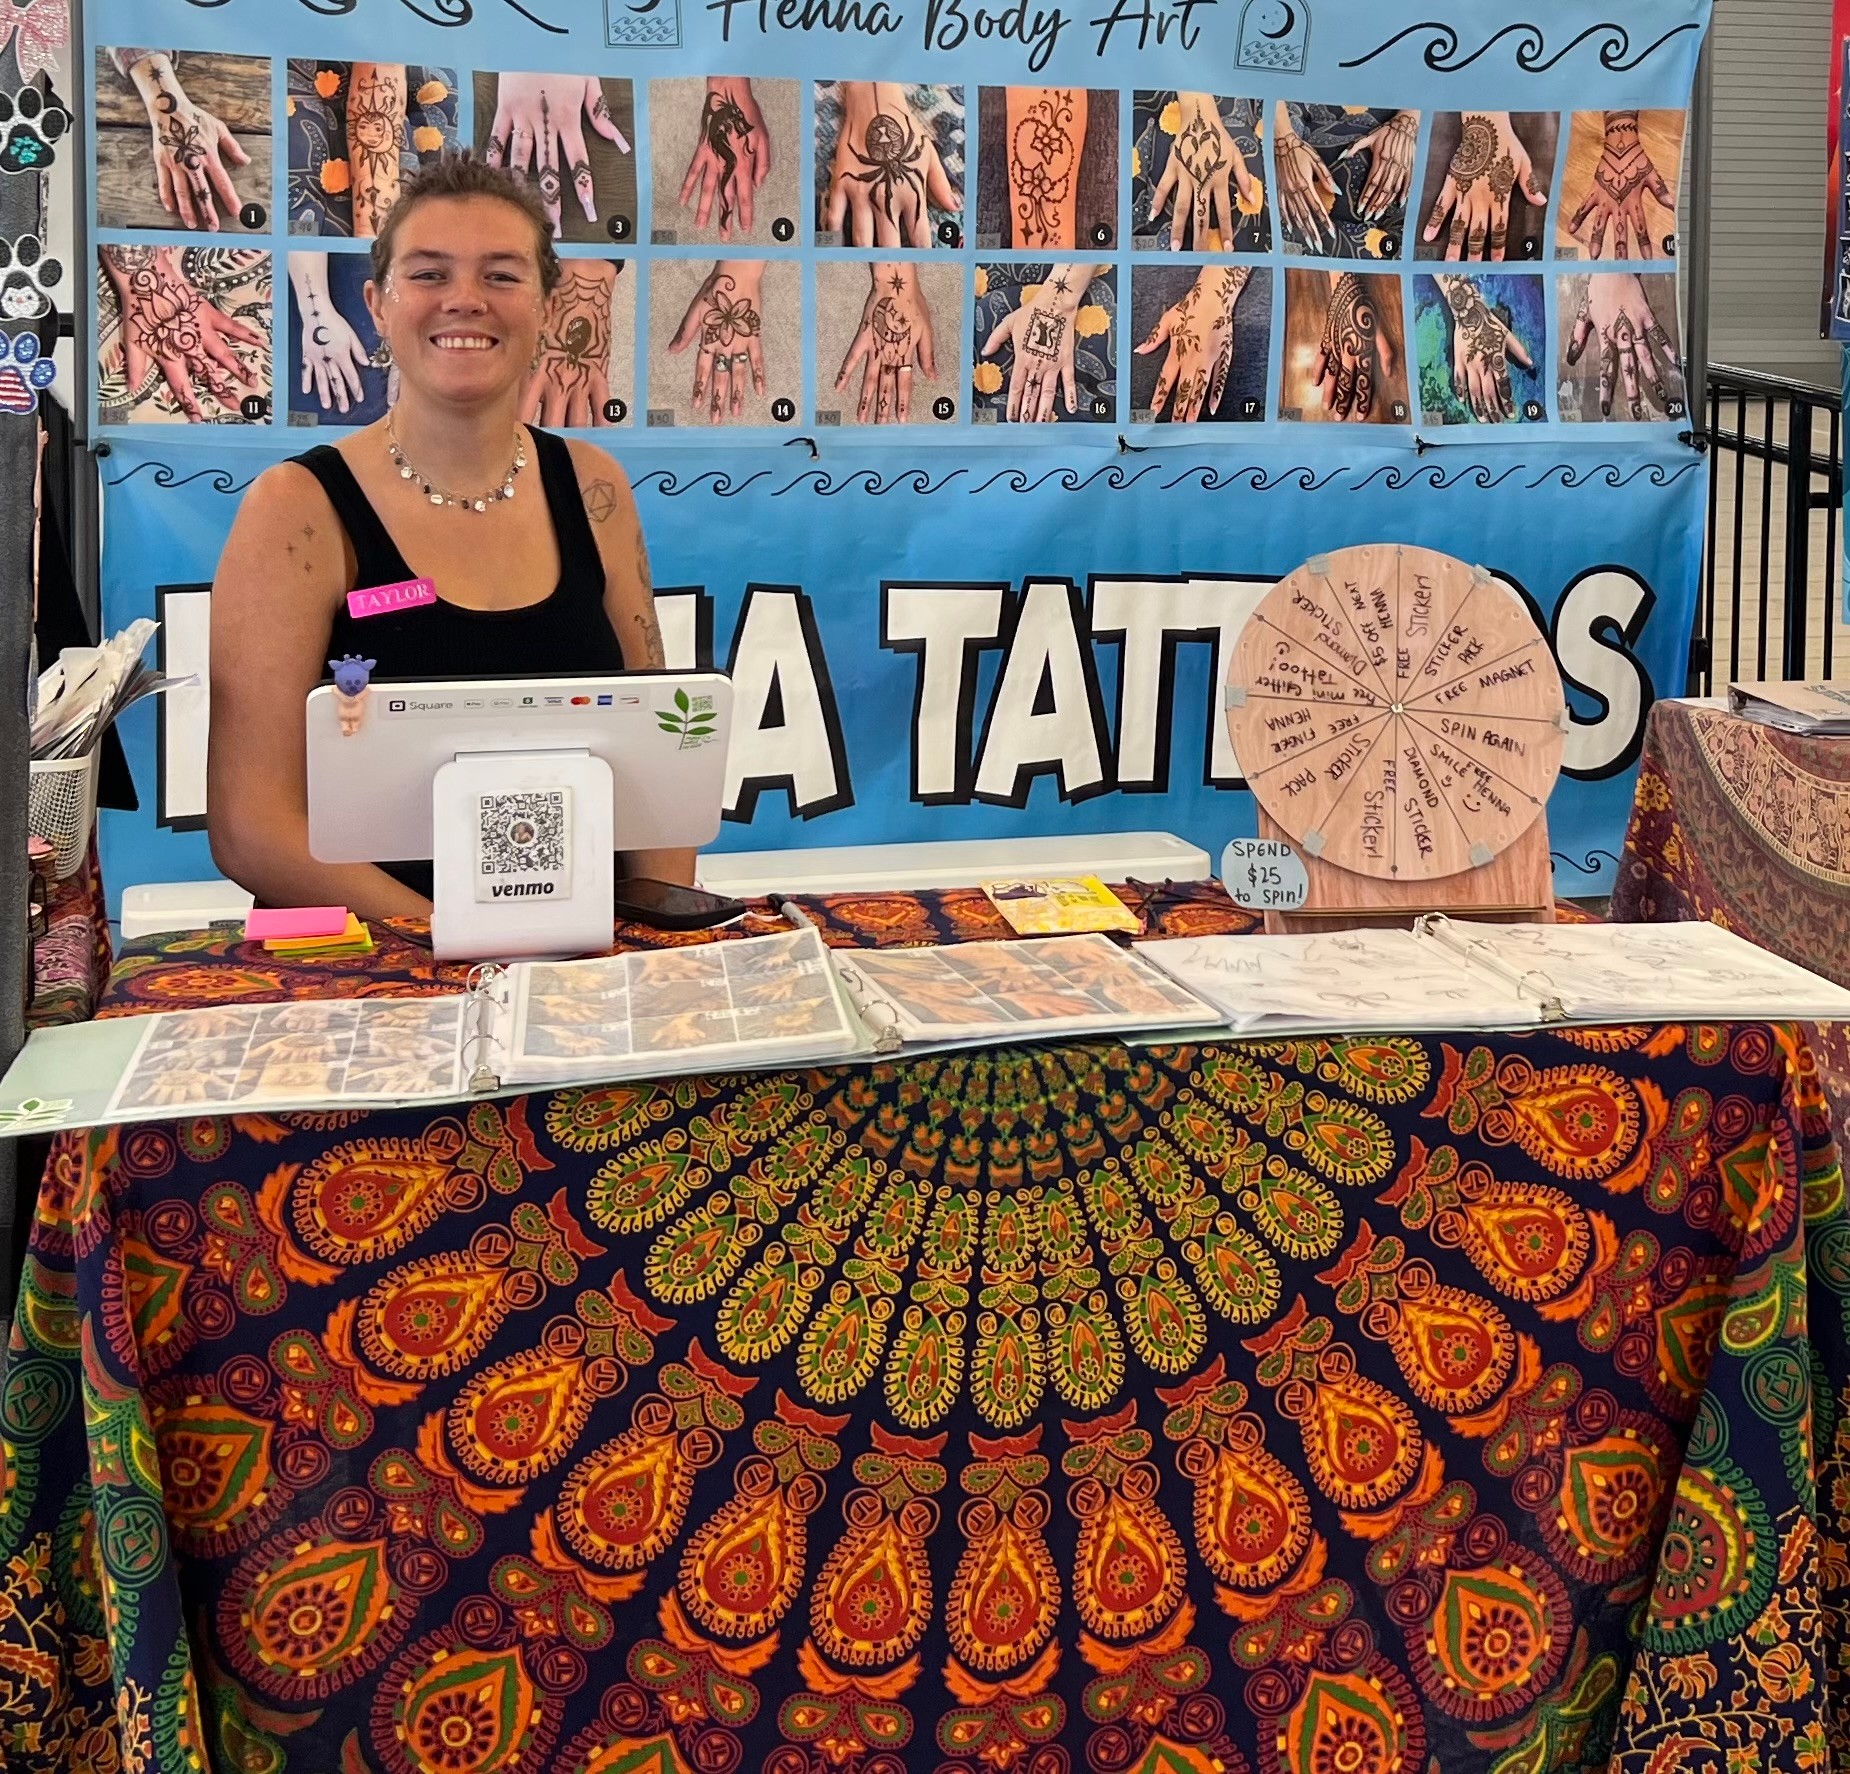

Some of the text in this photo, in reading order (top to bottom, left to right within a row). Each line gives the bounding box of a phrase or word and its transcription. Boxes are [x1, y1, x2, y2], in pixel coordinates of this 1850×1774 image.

[706, 0, 1217, 73] Henna Body Art
[355, 583, 432, 610] TAYLOR
[1292, 589, 1344, 637] STICKER
[1344, 581, 1367, 611] NEXT
[1370, 587, 1394, 629] HENNA
[1397, 647, 1411, 679] FREE
[1425, 625, 1469, 677] STICKER
[1457, 637, 1485, 665] PACK
[880, 566, 1657, 809] TATTS
[1435, 658, 1536, 705] FREE MAGNET
[410, 701, 454, 711] Square
[1264, 707, 1312, 731] HENNA
[1270, 714, 1360, 754] FREE FINGER
[1440, 718, 1526, 757] SPIN AGAIN
[1323, 732, 1372, 781] STICKER
[1465, 760, 1493, 783] FREE
[1279, 767, 1317, 798] PACK
[1382, 759, 1397, 794] FREE
[1403, 747, 1440, 809] DIAMOND
[1430, 743, 1512, 817] SMILE HENNA
[1404, 797, 1434, 860] STICKER
[1232, 840, 1291, 859] SPEND
[491, 882, 555, 898] venmo
[1247, 862, 1282, 888] $25
[1234, 887, 1251, 902] to
